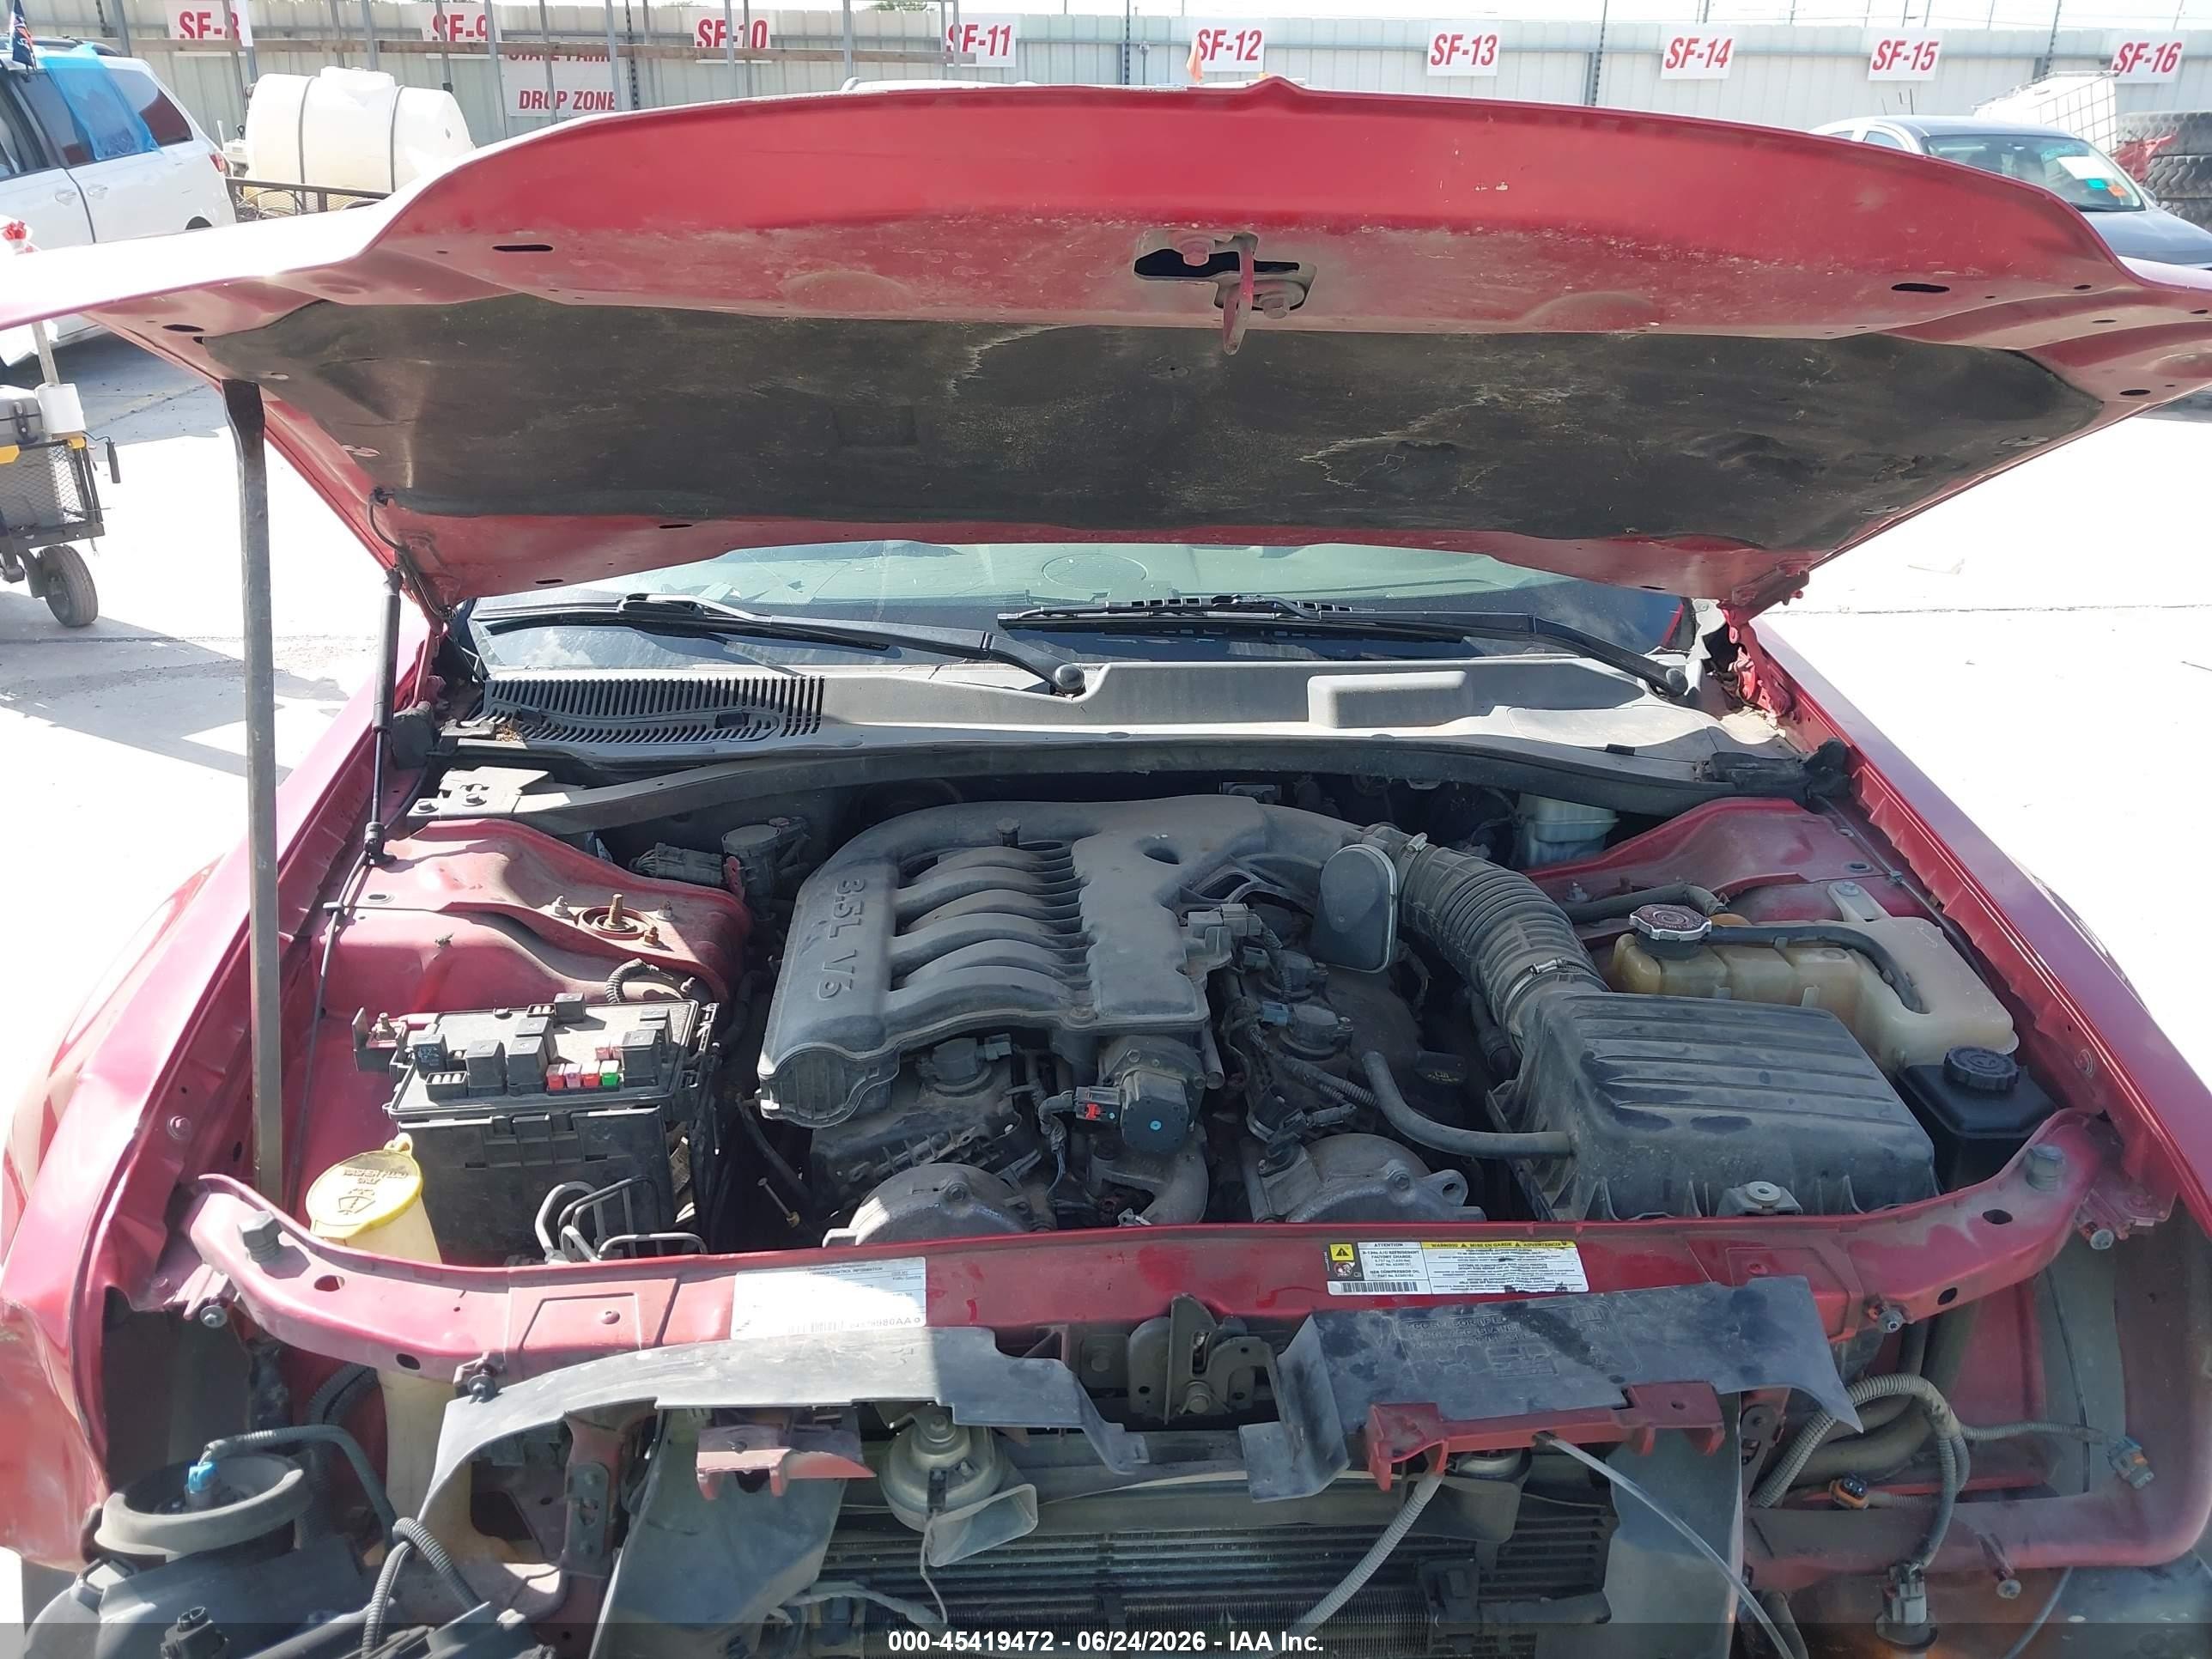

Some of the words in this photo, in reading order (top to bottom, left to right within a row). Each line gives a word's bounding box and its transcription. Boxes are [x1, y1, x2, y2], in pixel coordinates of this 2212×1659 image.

[946, 24, 1012, 57] SF-11
[1198, 28, 1263, 62] SF-12
[1430, 33, 1498, 67] SF-13
[1664, 36, 1734, 70] SF-14
[1871, 39, 1941, 71] SF-15
[2112, 41, 2183, 76] SF-16
[519, 89, 568, 110] DROP
[572, 89, 616, 111] ZONE
